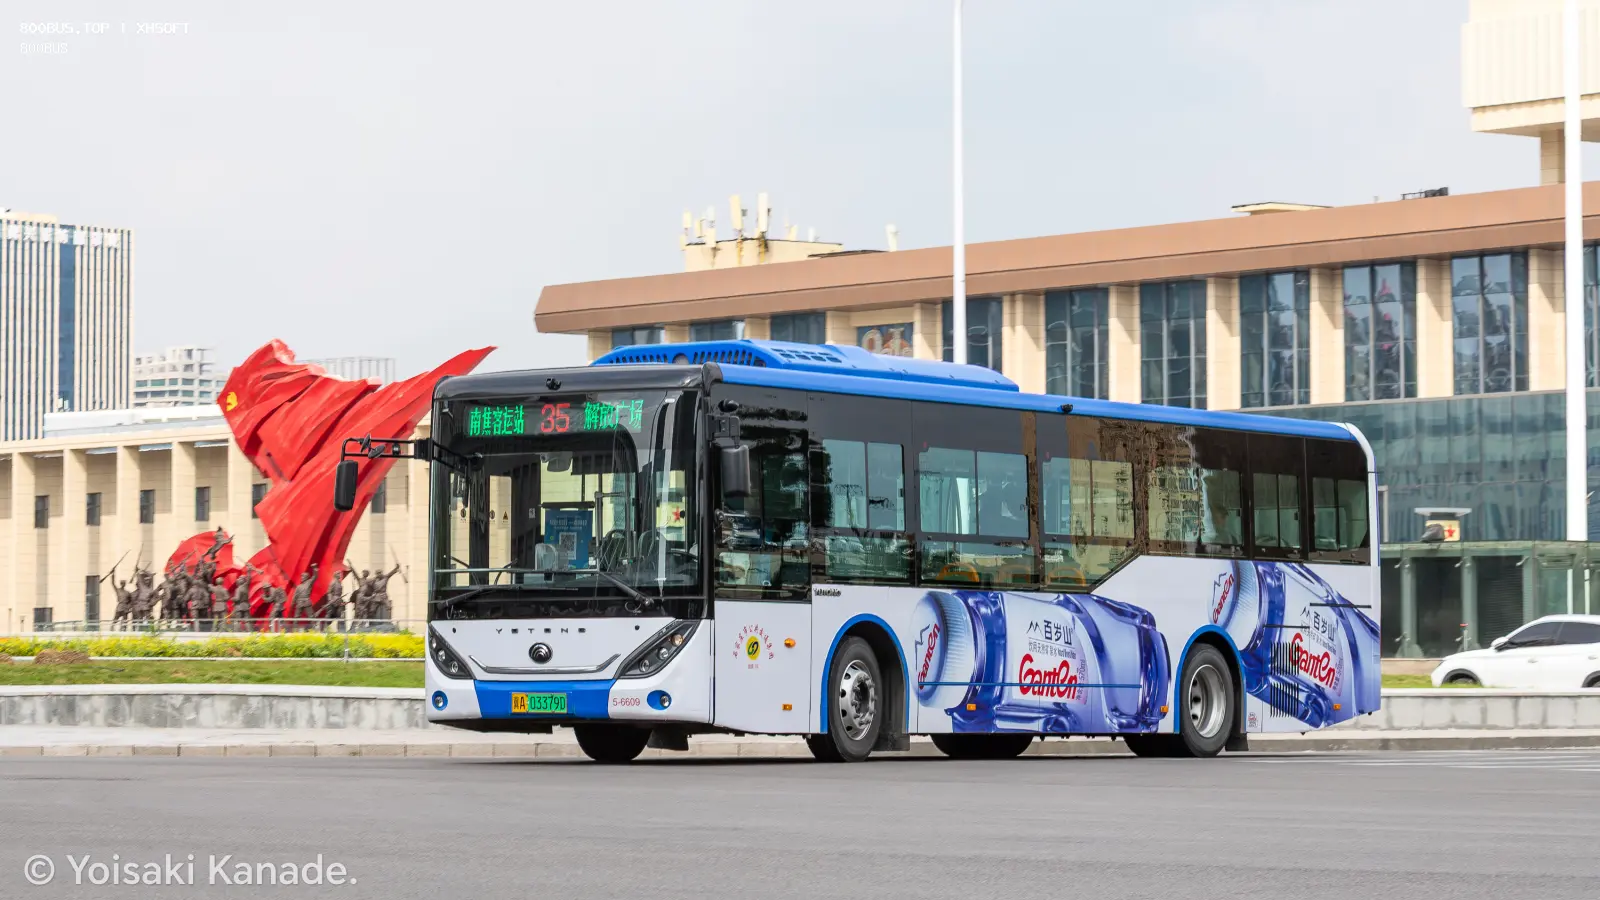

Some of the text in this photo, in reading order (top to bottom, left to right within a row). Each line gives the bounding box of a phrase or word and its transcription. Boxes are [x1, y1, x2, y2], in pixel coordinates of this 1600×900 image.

[470, 399, 644, 437] 南焦客运站 35 解放广场
[1043, 619, 1073, 646] 百岁山
[1313, 611, 1336, 642] 百岁山
[612, 697, 641, 707] 5-6609
